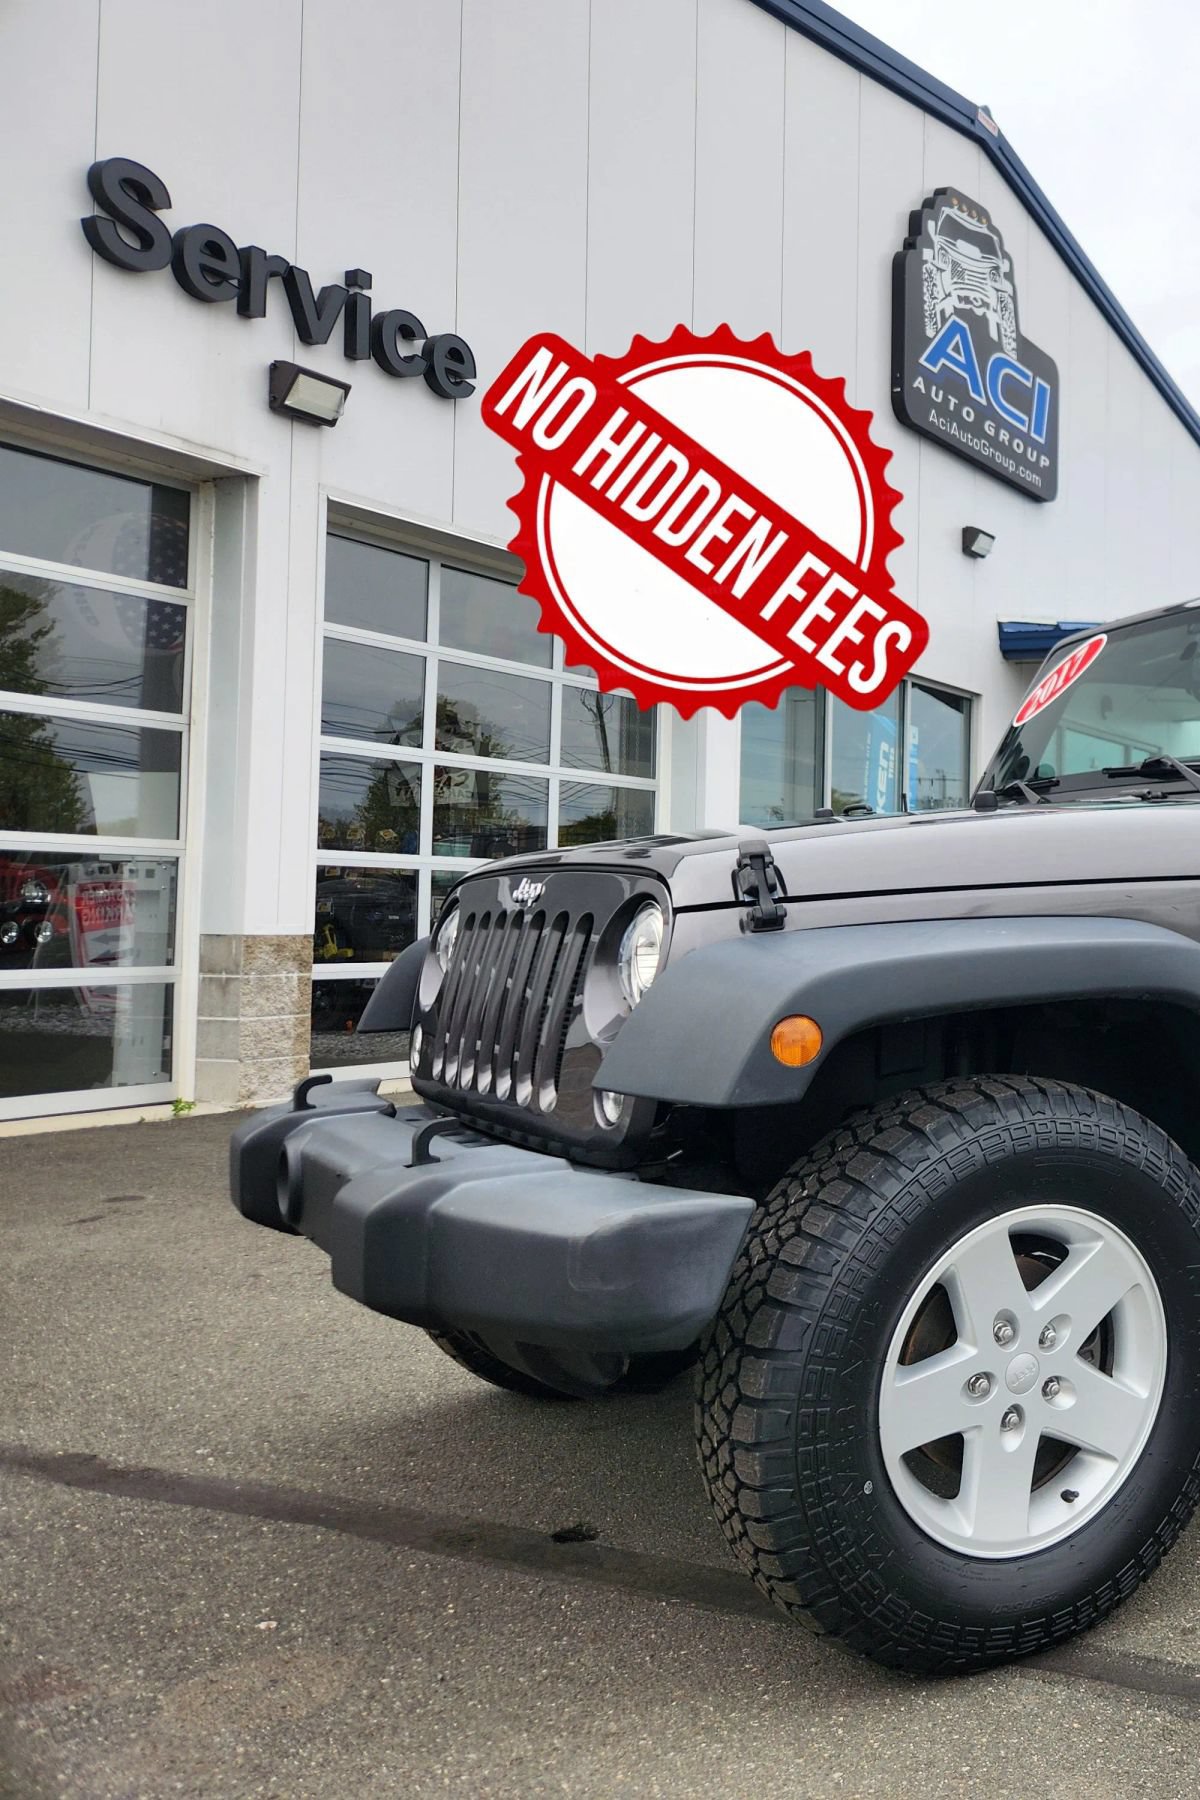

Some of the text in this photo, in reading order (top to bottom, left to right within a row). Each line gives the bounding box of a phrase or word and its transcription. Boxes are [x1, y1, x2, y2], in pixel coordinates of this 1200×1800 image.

[81, 157, 477, 399] Service
[913, 376, 1050, 469] AUTO GROUP
[919, 314, 1050, 445] ACI
[929, 408, 1042, 488] AciAutoGroup.com
[1023, 644, 1090, 721] 2017
